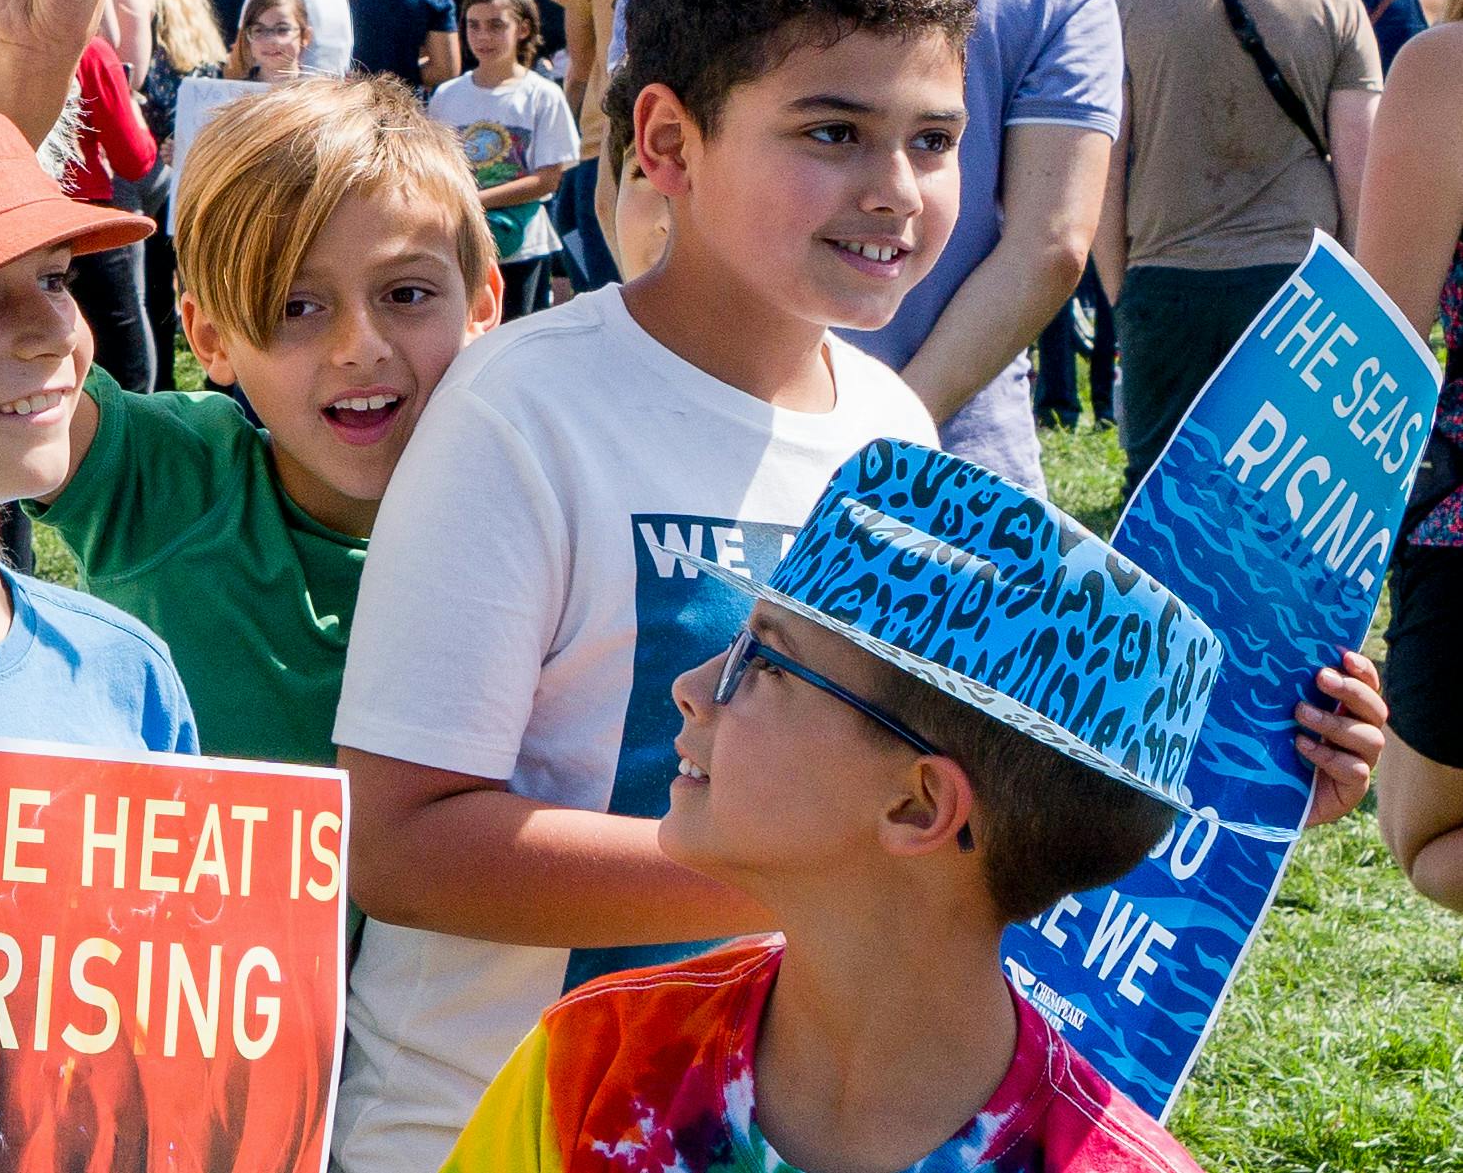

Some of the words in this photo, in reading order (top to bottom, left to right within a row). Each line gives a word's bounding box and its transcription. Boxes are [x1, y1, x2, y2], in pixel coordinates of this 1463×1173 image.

[1260, 275, 1360, 393] THE
[1332, 356, 1424, 475] SEAS
[638, 522, 753, 580] WE
[1223, 400, 1391, 593] RISING
[80, 794, 269, 898] HEAT
[289, 809, 342, 902] IS
[1082, 889, 1178, 1007] WE
[1033, 981, 1087, 1030] CHESAPEAKE
